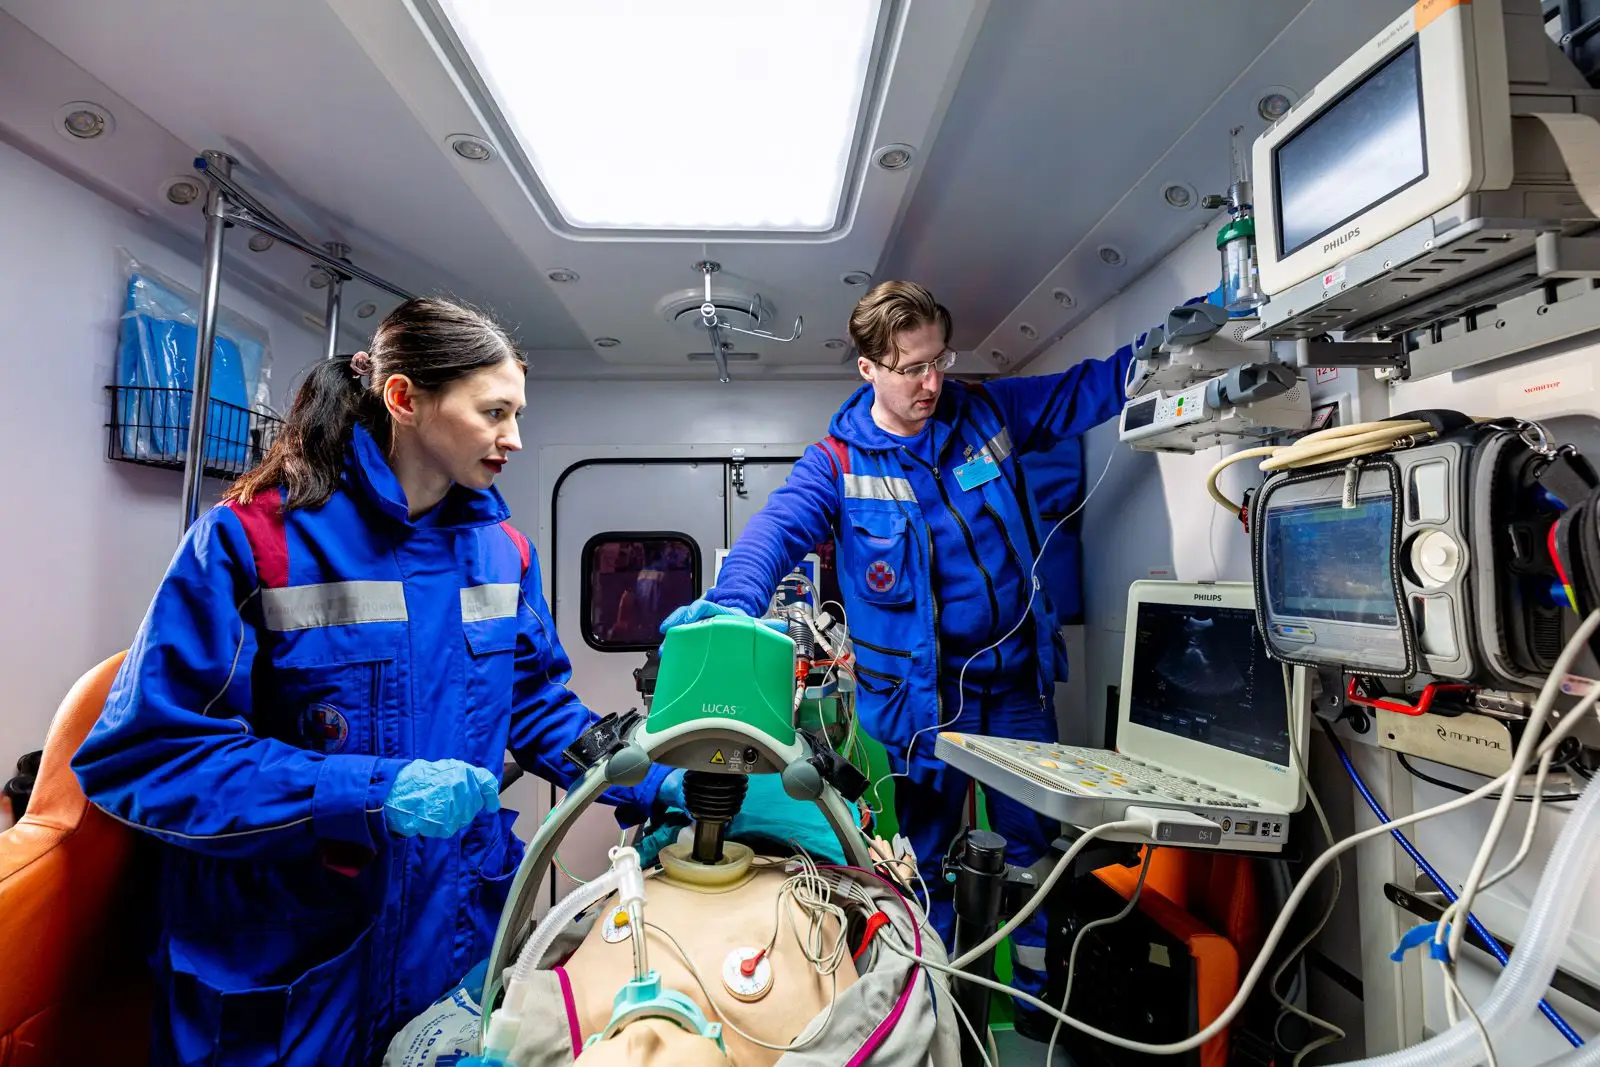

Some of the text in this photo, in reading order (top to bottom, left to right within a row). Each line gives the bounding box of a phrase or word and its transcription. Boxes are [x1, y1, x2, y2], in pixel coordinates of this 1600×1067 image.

[1323, 227, 1361, 253] PHILIPS
[1193, 593, 1222, 602] PHILIPS
[702, 703, 737, 715] LUCAS
